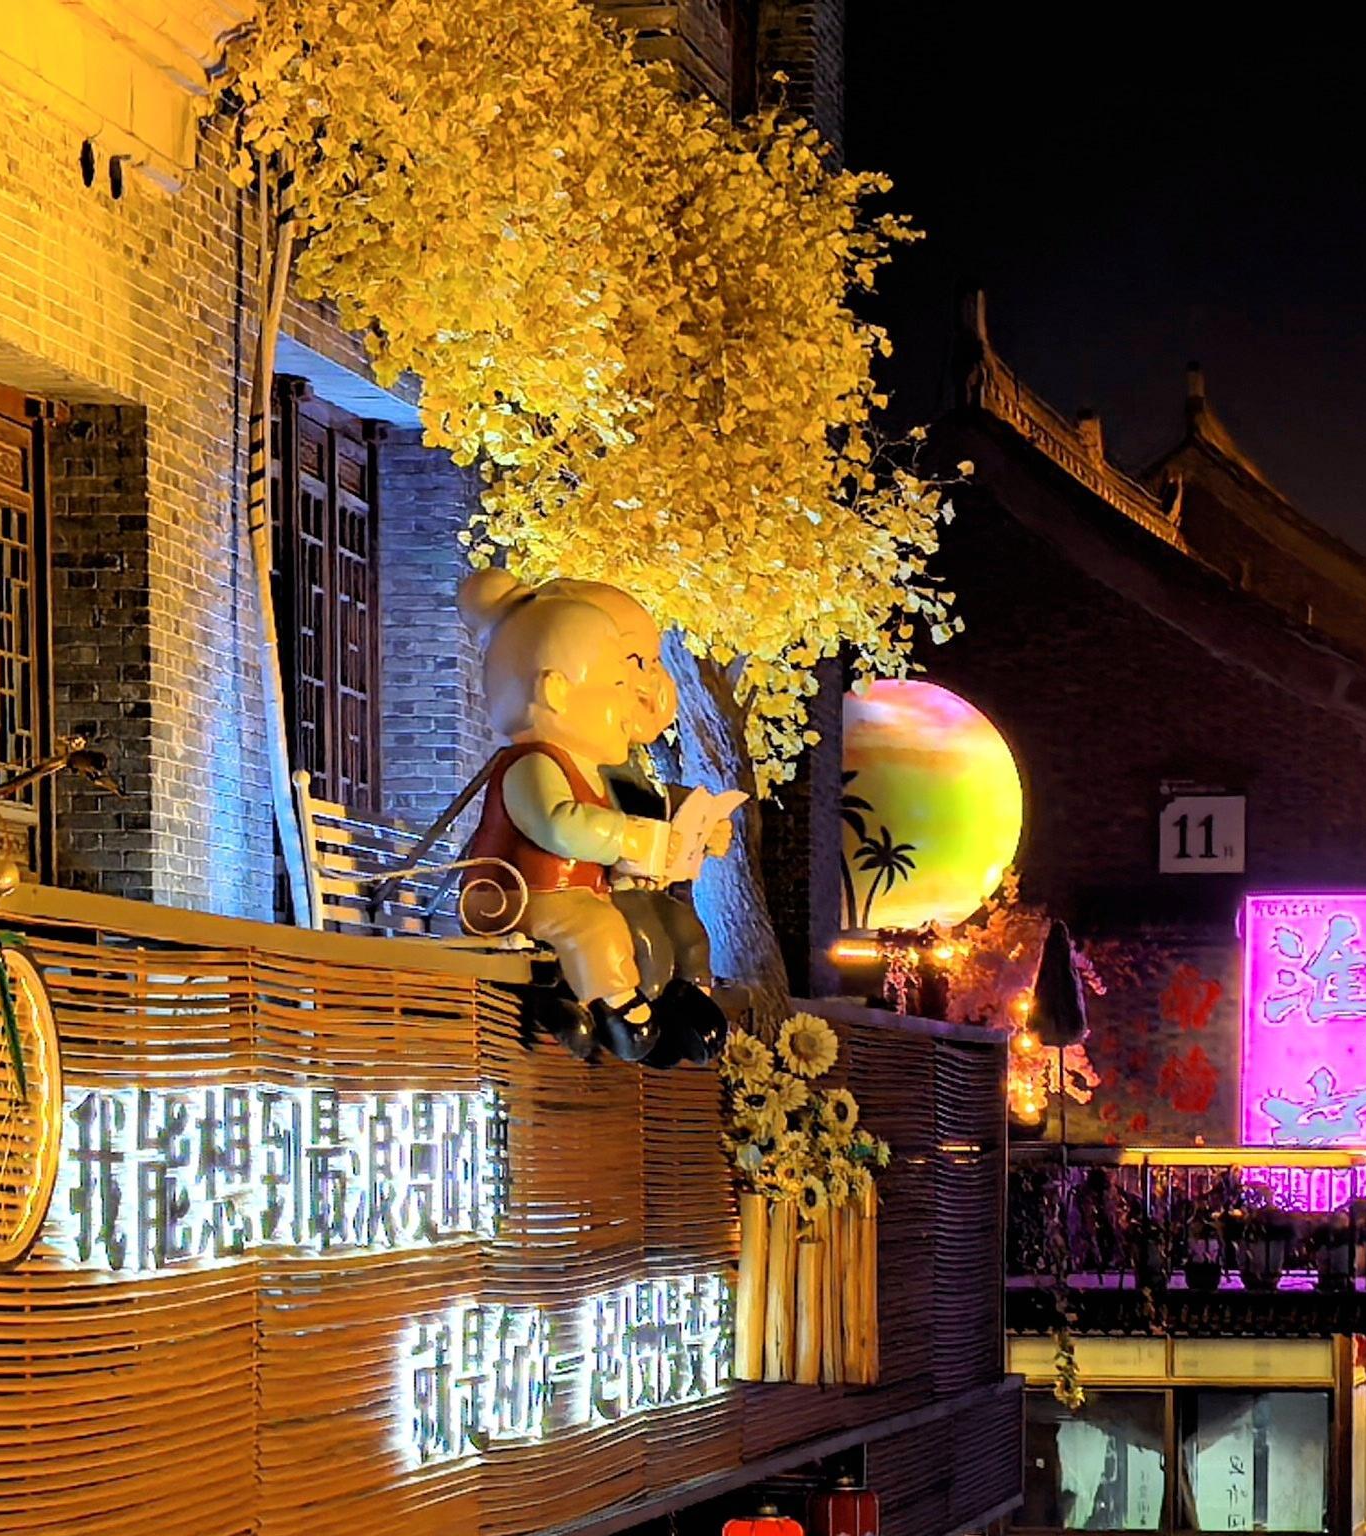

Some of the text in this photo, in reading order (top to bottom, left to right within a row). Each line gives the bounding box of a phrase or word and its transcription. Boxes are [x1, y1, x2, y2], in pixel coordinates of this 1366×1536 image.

[1172, 813, 1219, 859] 11
[67, 1085, 511, 1271] 我能想到最浪漫的事
